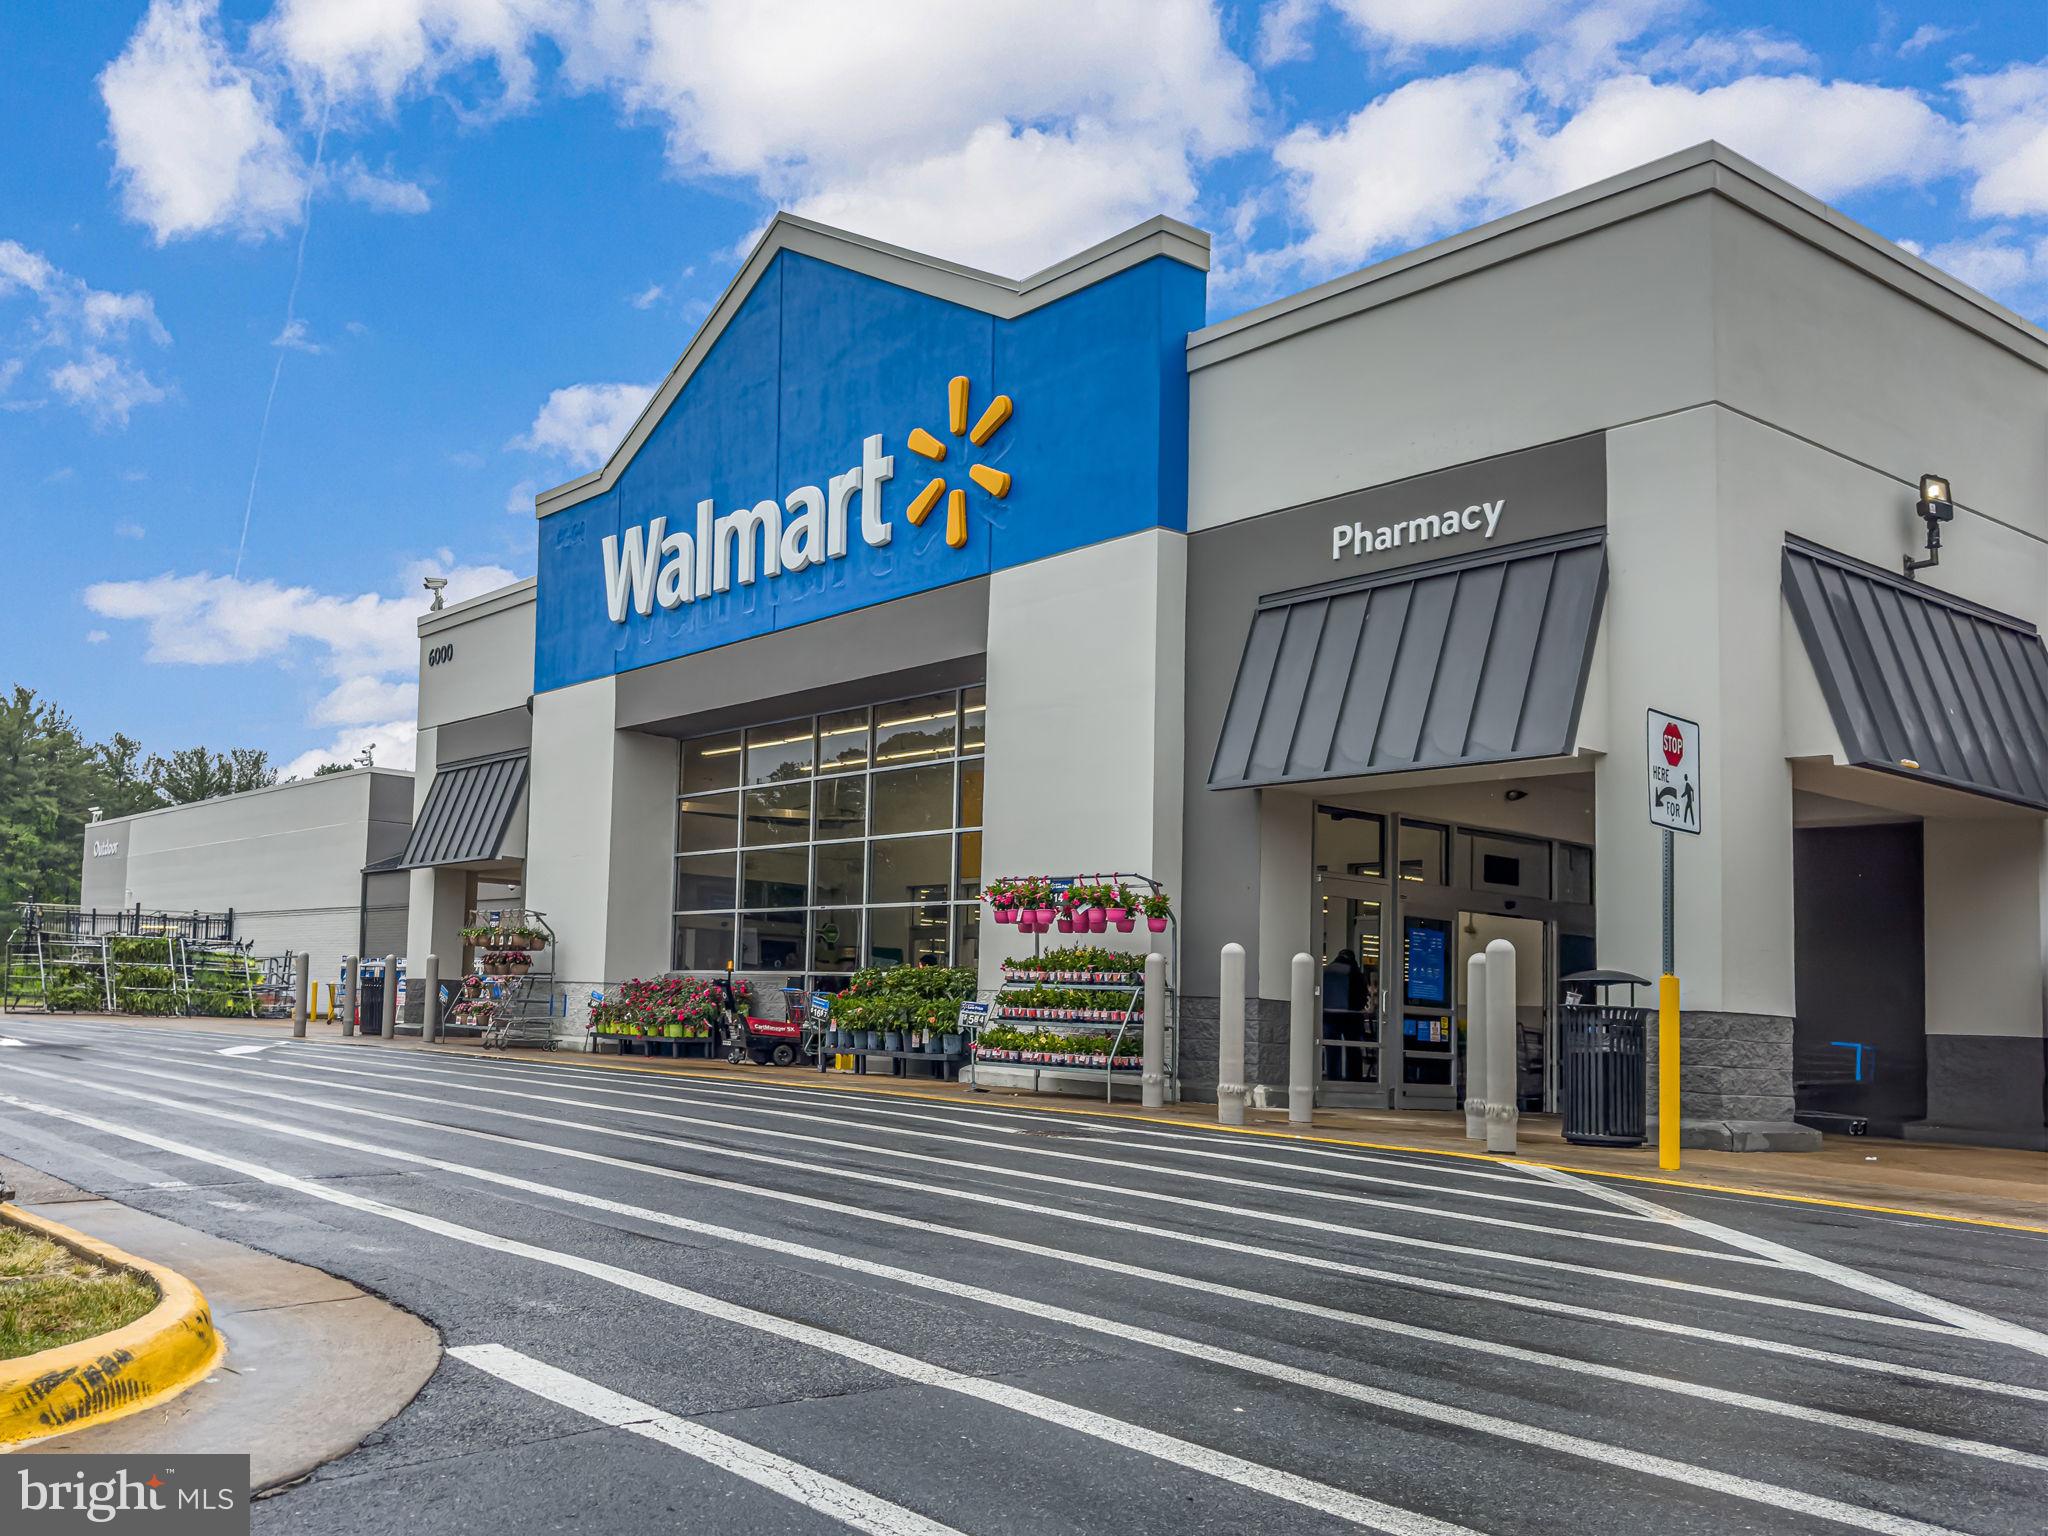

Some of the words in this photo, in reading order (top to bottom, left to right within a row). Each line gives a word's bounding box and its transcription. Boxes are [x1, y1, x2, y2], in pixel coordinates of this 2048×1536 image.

[602, 434, 894, 624] Walmart
[1333, 500, 1506, 560] Pharmacy
[428, 643, 453, 667] 6000
[1663, 735, 1683, 754] STOP
[1653, 765, 1670, 783] HERE
[1666, 801, 1681, 818] FOR
[94, 839, 119, 857] Outdoor
[754, 1023, 786, 1032] CartManager
